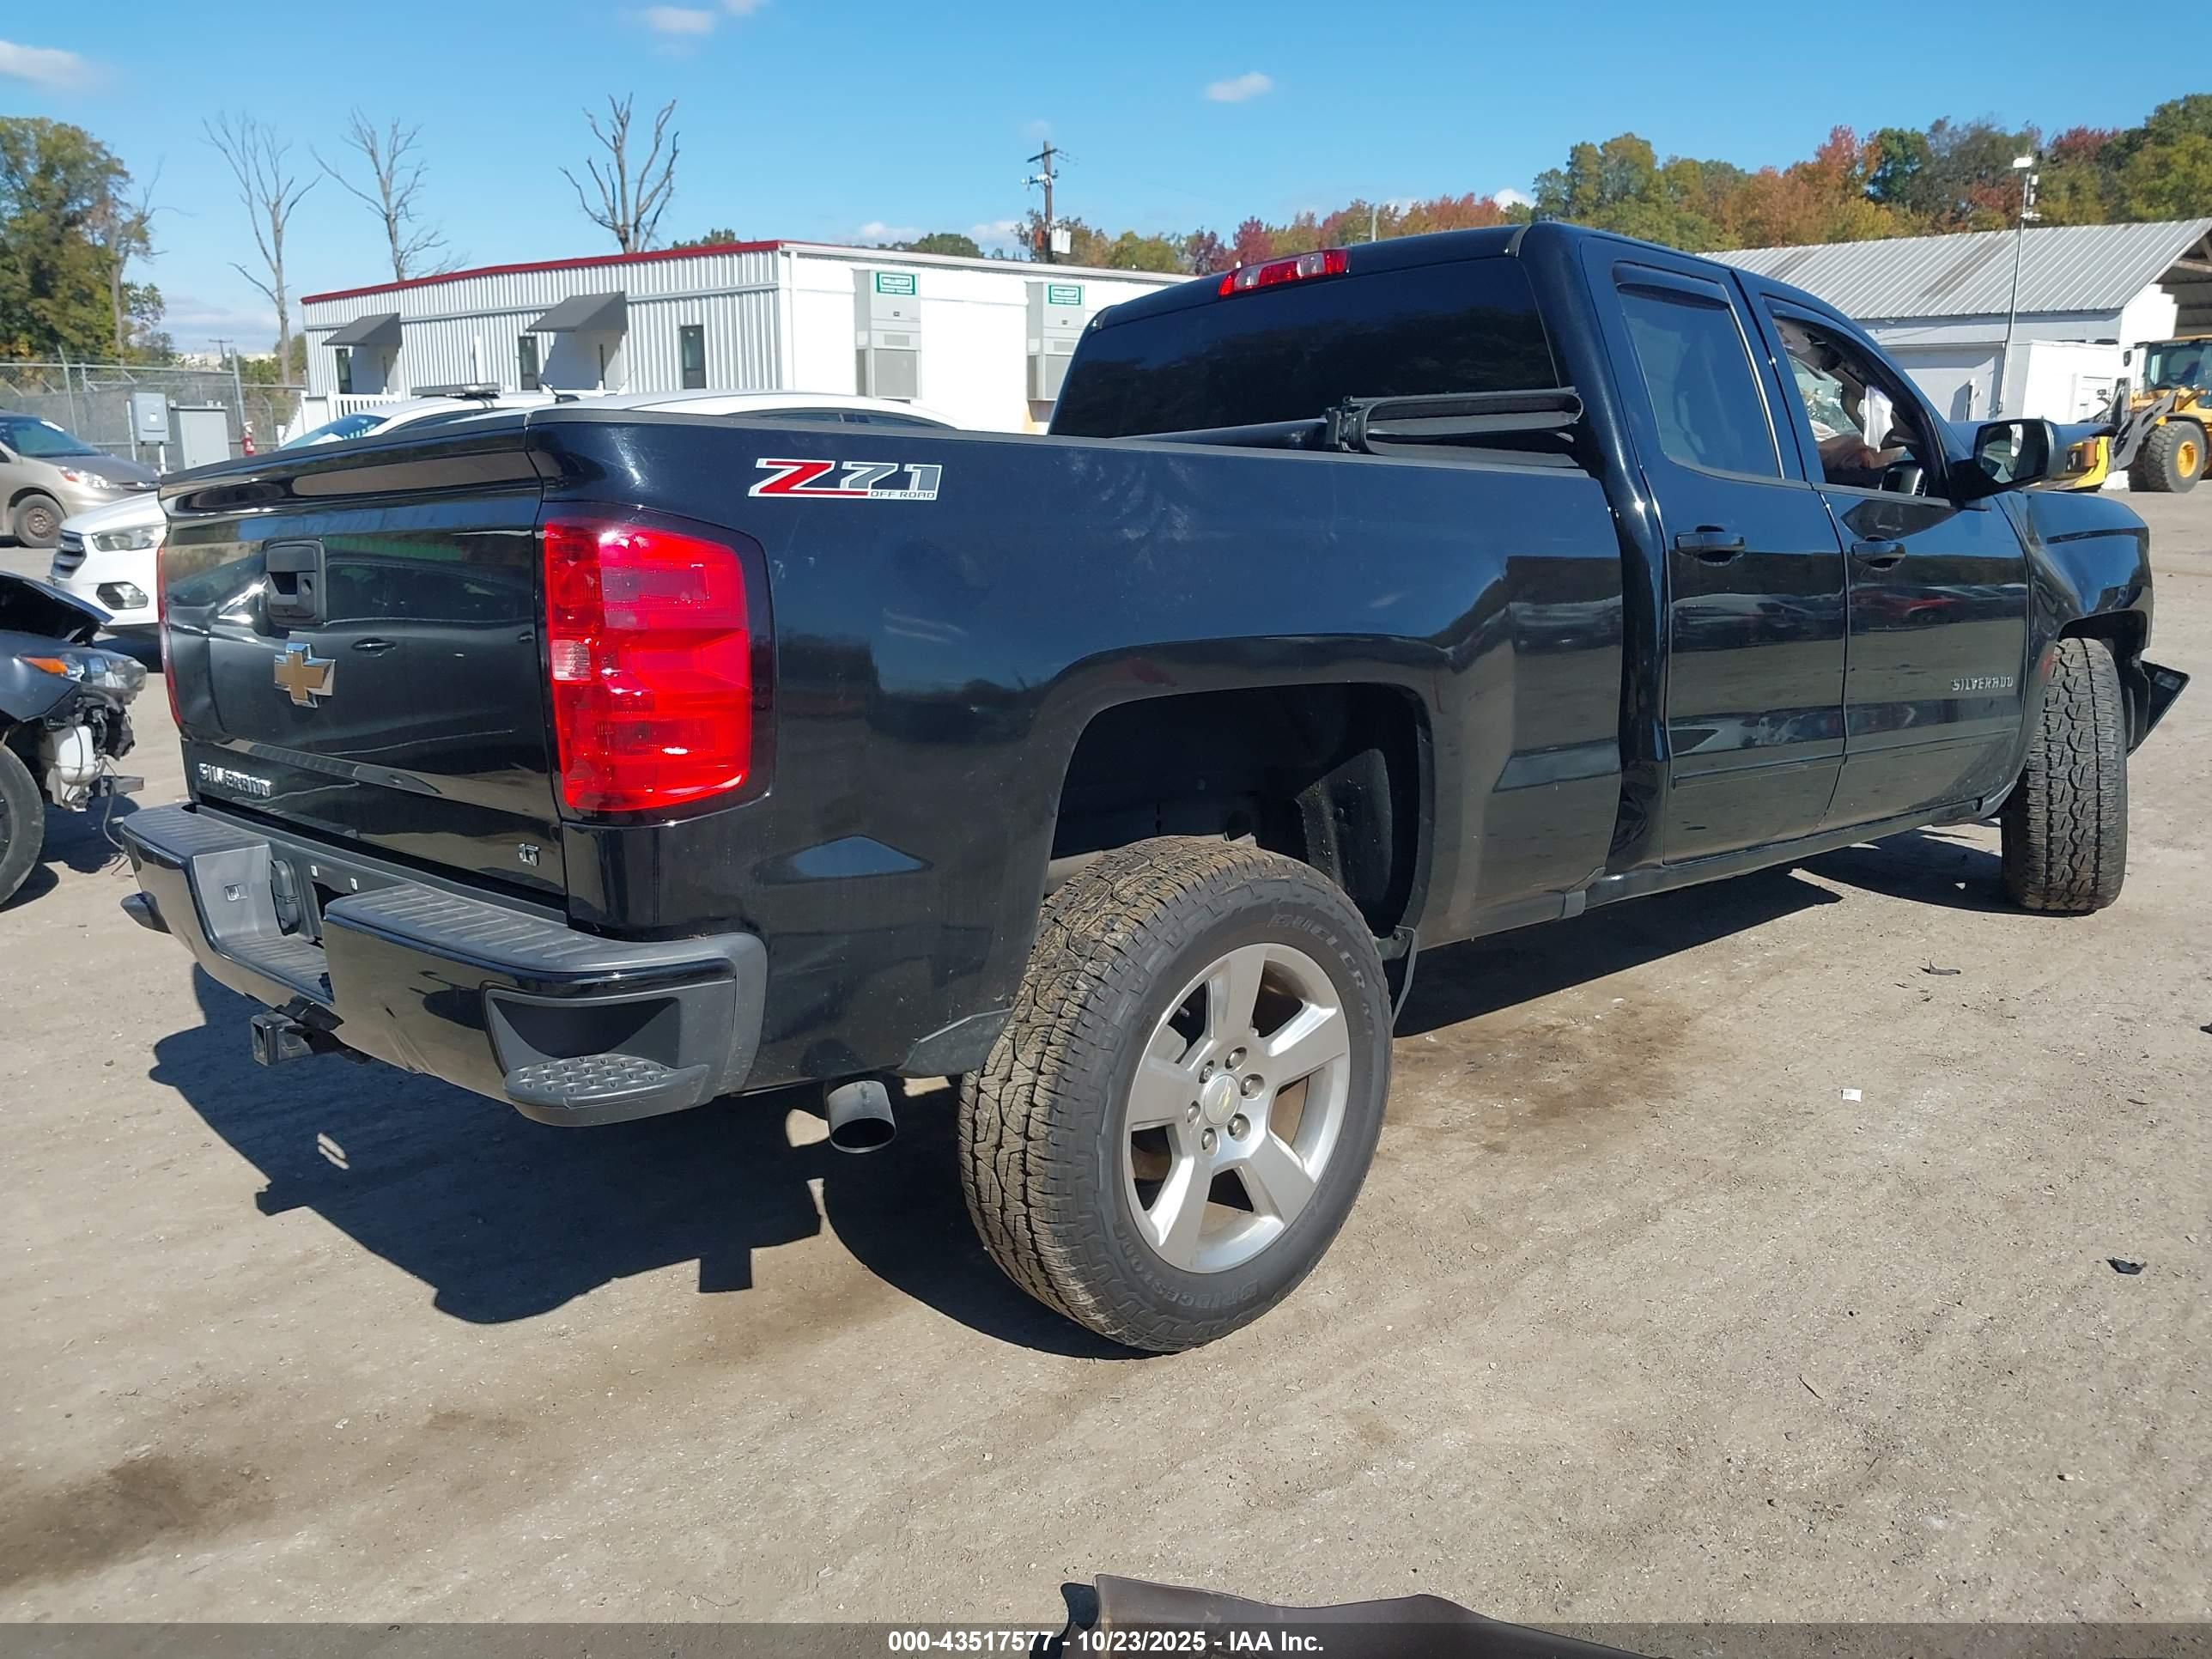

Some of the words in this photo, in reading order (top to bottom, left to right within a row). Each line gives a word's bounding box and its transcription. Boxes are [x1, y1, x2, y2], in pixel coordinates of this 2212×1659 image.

[748, 458, 943, 497] Z71
[899, 490, 935, 499] ROAD
[1952, 676, 2014, 691] SILVERADO
